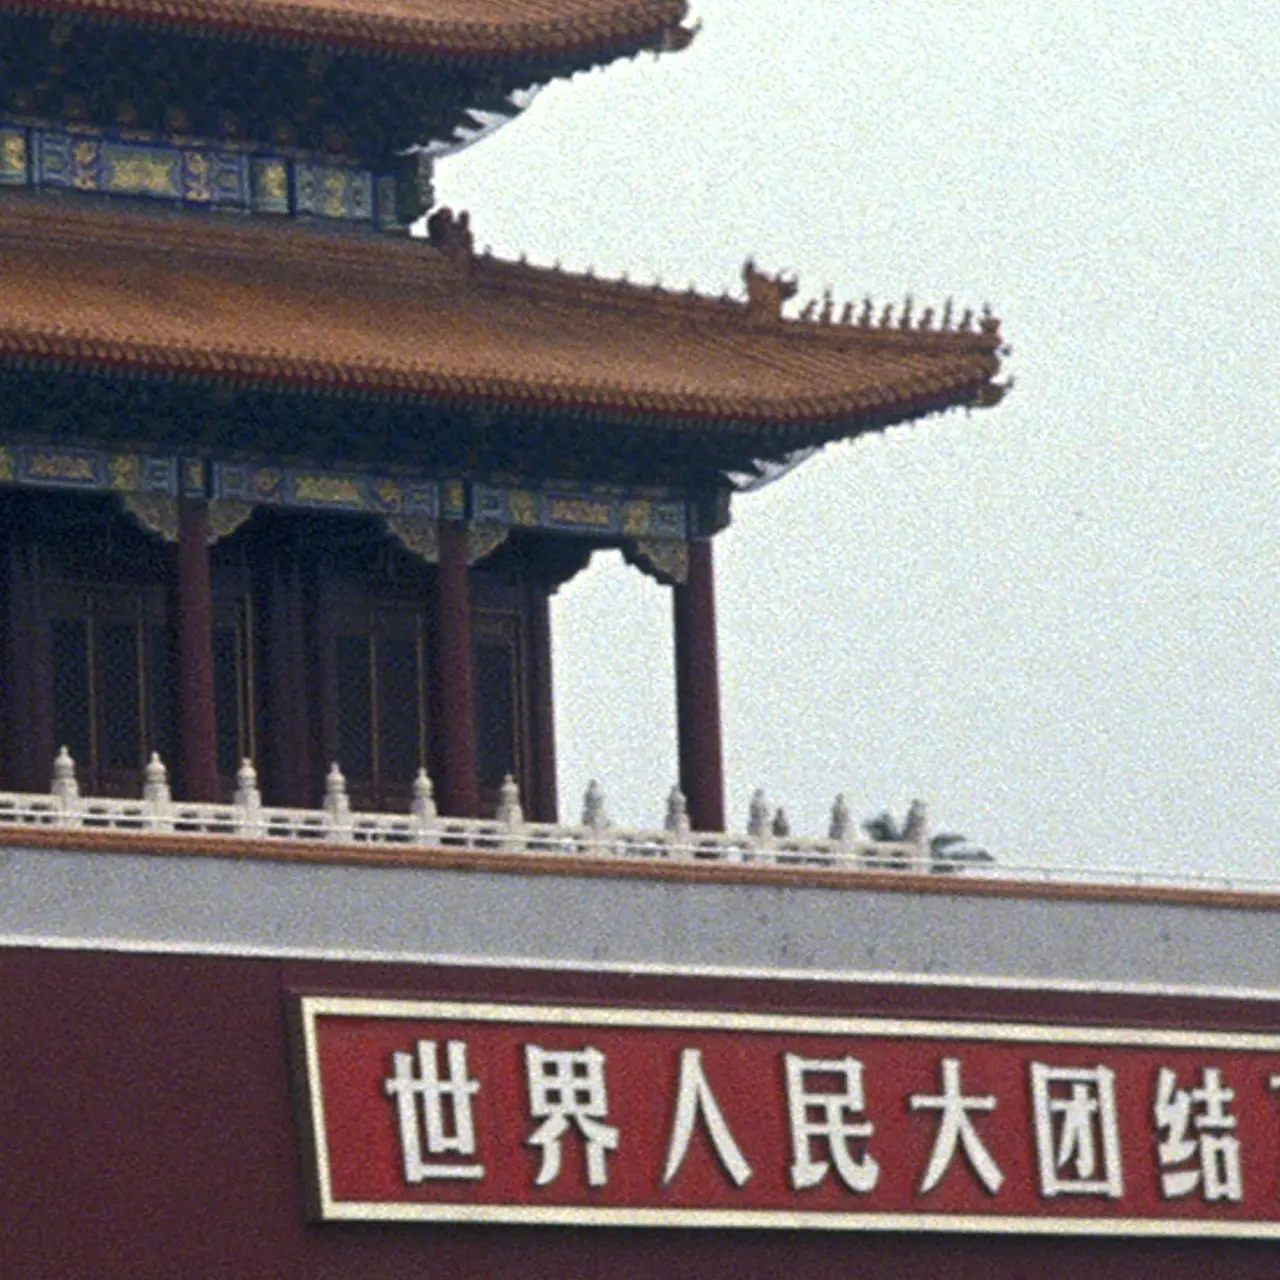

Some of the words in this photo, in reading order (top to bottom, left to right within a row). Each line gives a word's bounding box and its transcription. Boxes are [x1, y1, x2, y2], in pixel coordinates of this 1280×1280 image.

[384, 1038, 1280, 1201] 世界人民大团结
